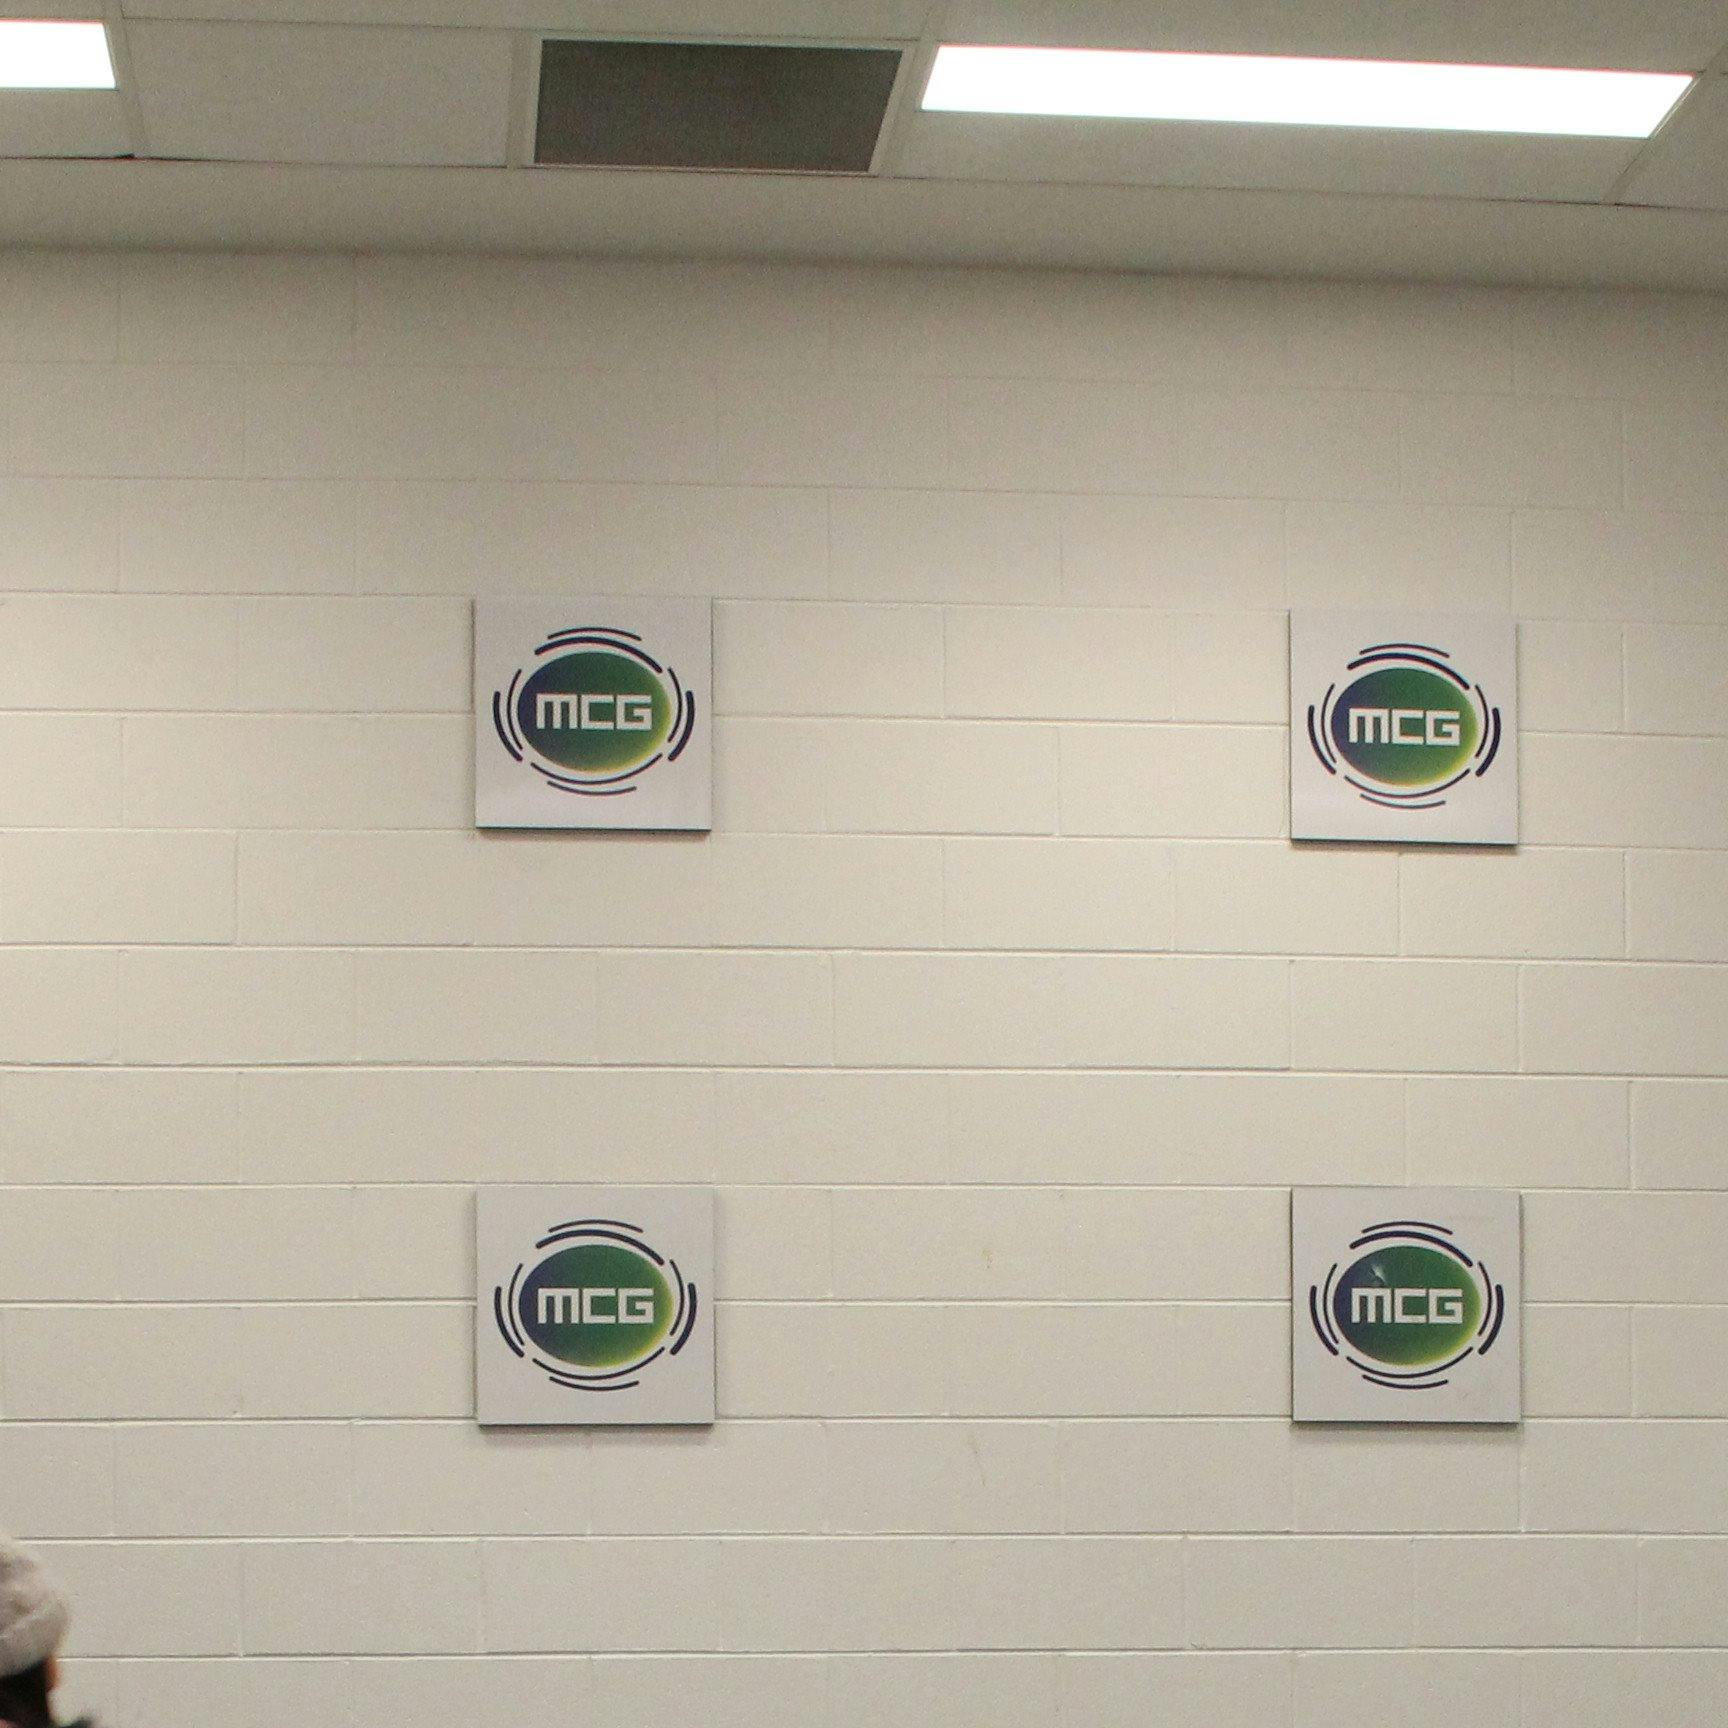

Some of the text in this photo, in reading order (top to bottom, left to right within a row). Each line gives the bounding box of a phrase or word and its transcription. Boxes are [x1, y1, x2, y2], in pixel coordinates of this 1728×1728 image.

[535, 693, 653, 731] MCG
[1348, 708, 1462, 746] MCG
[536, 1288, 655, 1326] MCG
[1350, 1287, 1463, 1325] MCG
